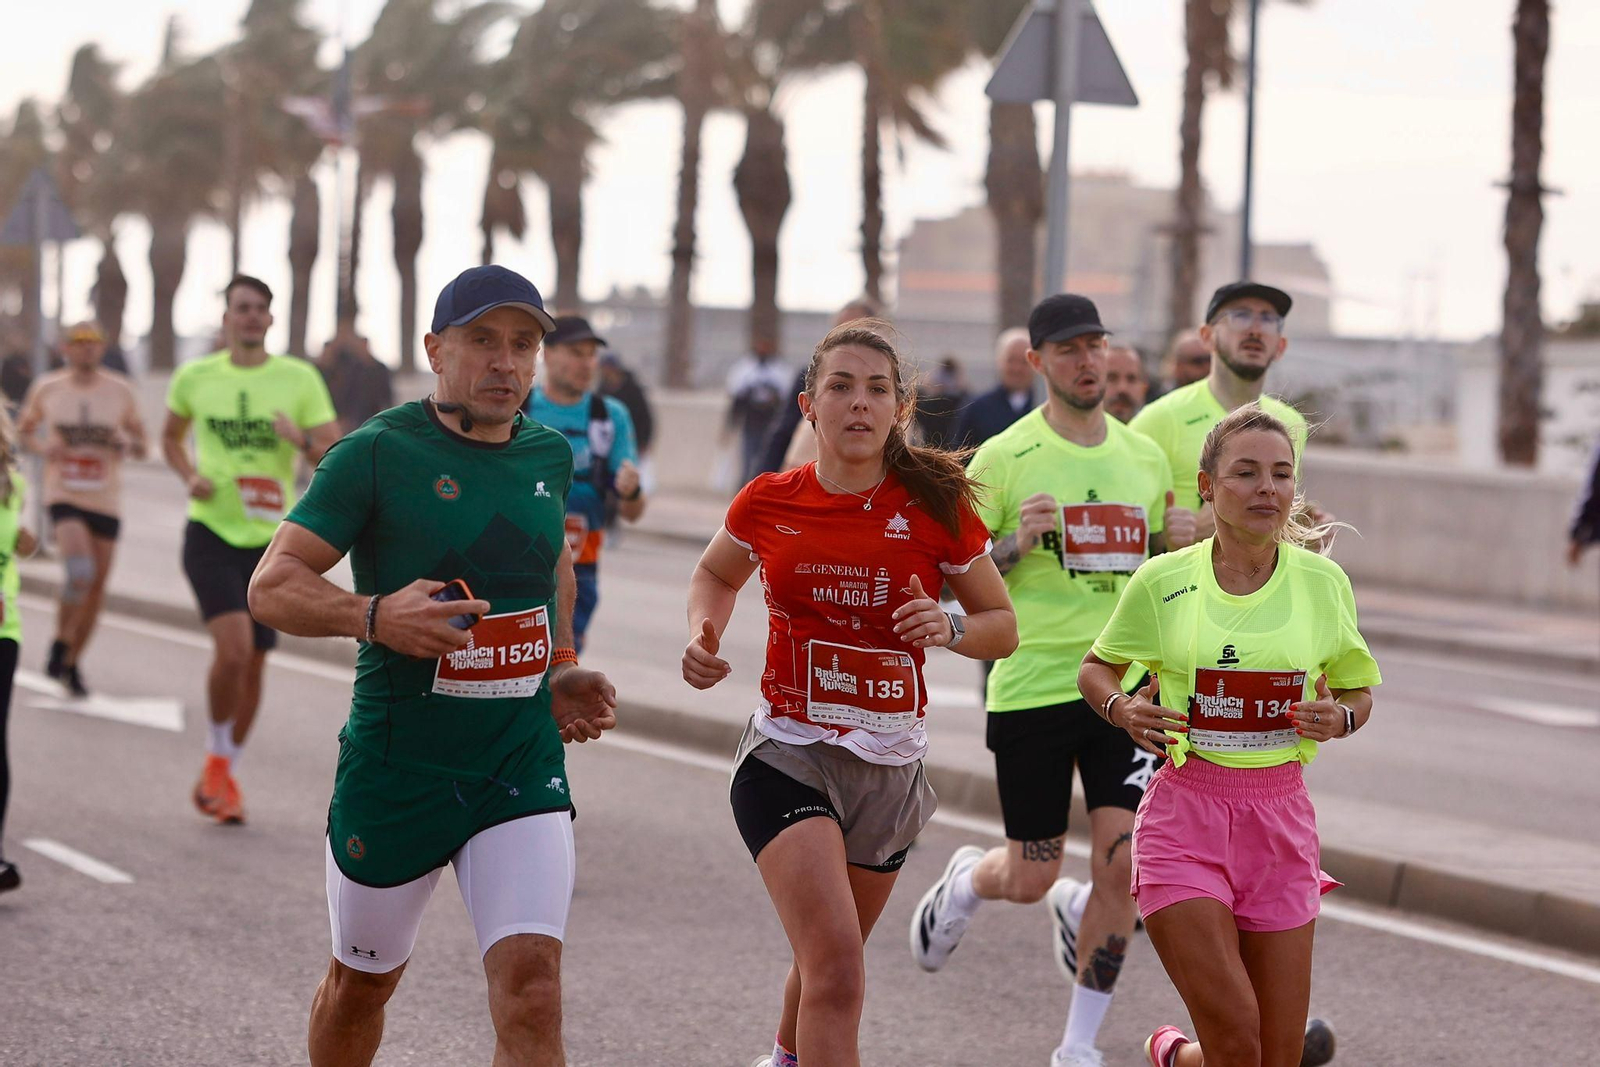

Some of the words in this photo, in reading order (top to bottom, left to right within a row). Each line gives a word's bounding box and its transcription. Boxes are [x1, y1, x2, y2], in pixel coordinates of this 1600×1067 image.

[884, 531, 911, 541] luanvi
[1113, 525, 1141, 543] 114
[812, 564, 869, 577] GENERALI
[840, 580, 869, 590] MARATÓN
[812, 585, 869, 607] MÁLAGA
[1162, 586, 1188, 603] luanvi
[497, 639, 546, 665] 1526
[814, 666, 857, 685] BRUNCH
[819, 677, 841, 691] RUN
[865, 680, 904, 699] 135
[1195, 692, 1244, 708] BRUNCH
[1200, 704, 1224, 718] RUN
[794, 805, 828, 815] PROJECT
